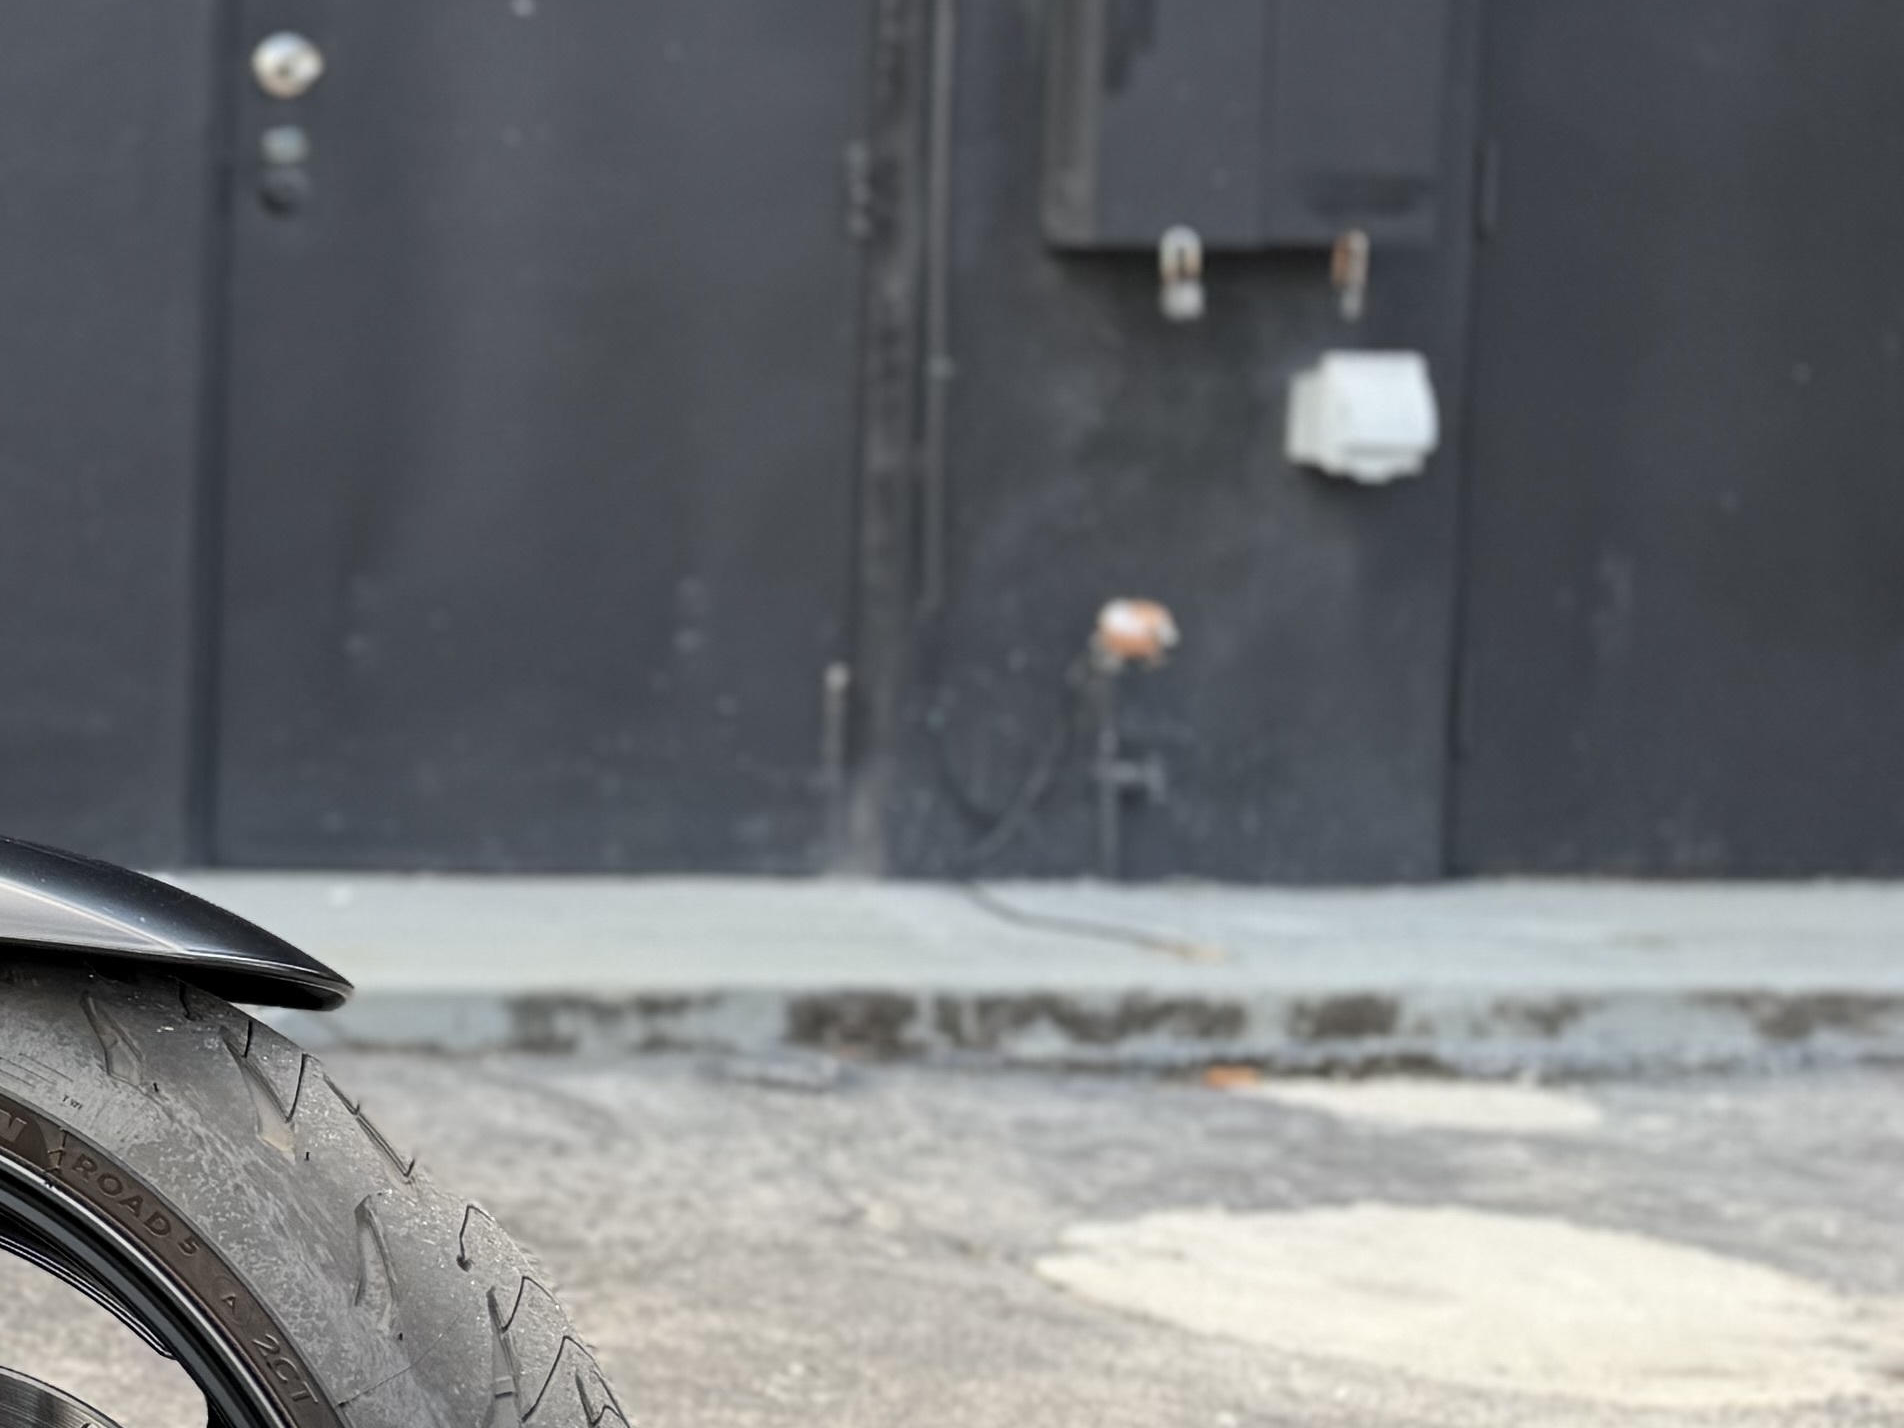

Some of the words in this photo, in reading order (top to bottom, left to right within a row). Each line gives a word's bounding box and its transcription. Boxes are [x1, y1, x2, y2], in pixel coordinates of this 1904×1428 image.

[71, 1152, 173, 1238] ROAD
[178, 1232, 201, 1256] 5
[251, 1333, 320, 1405] 2CT
